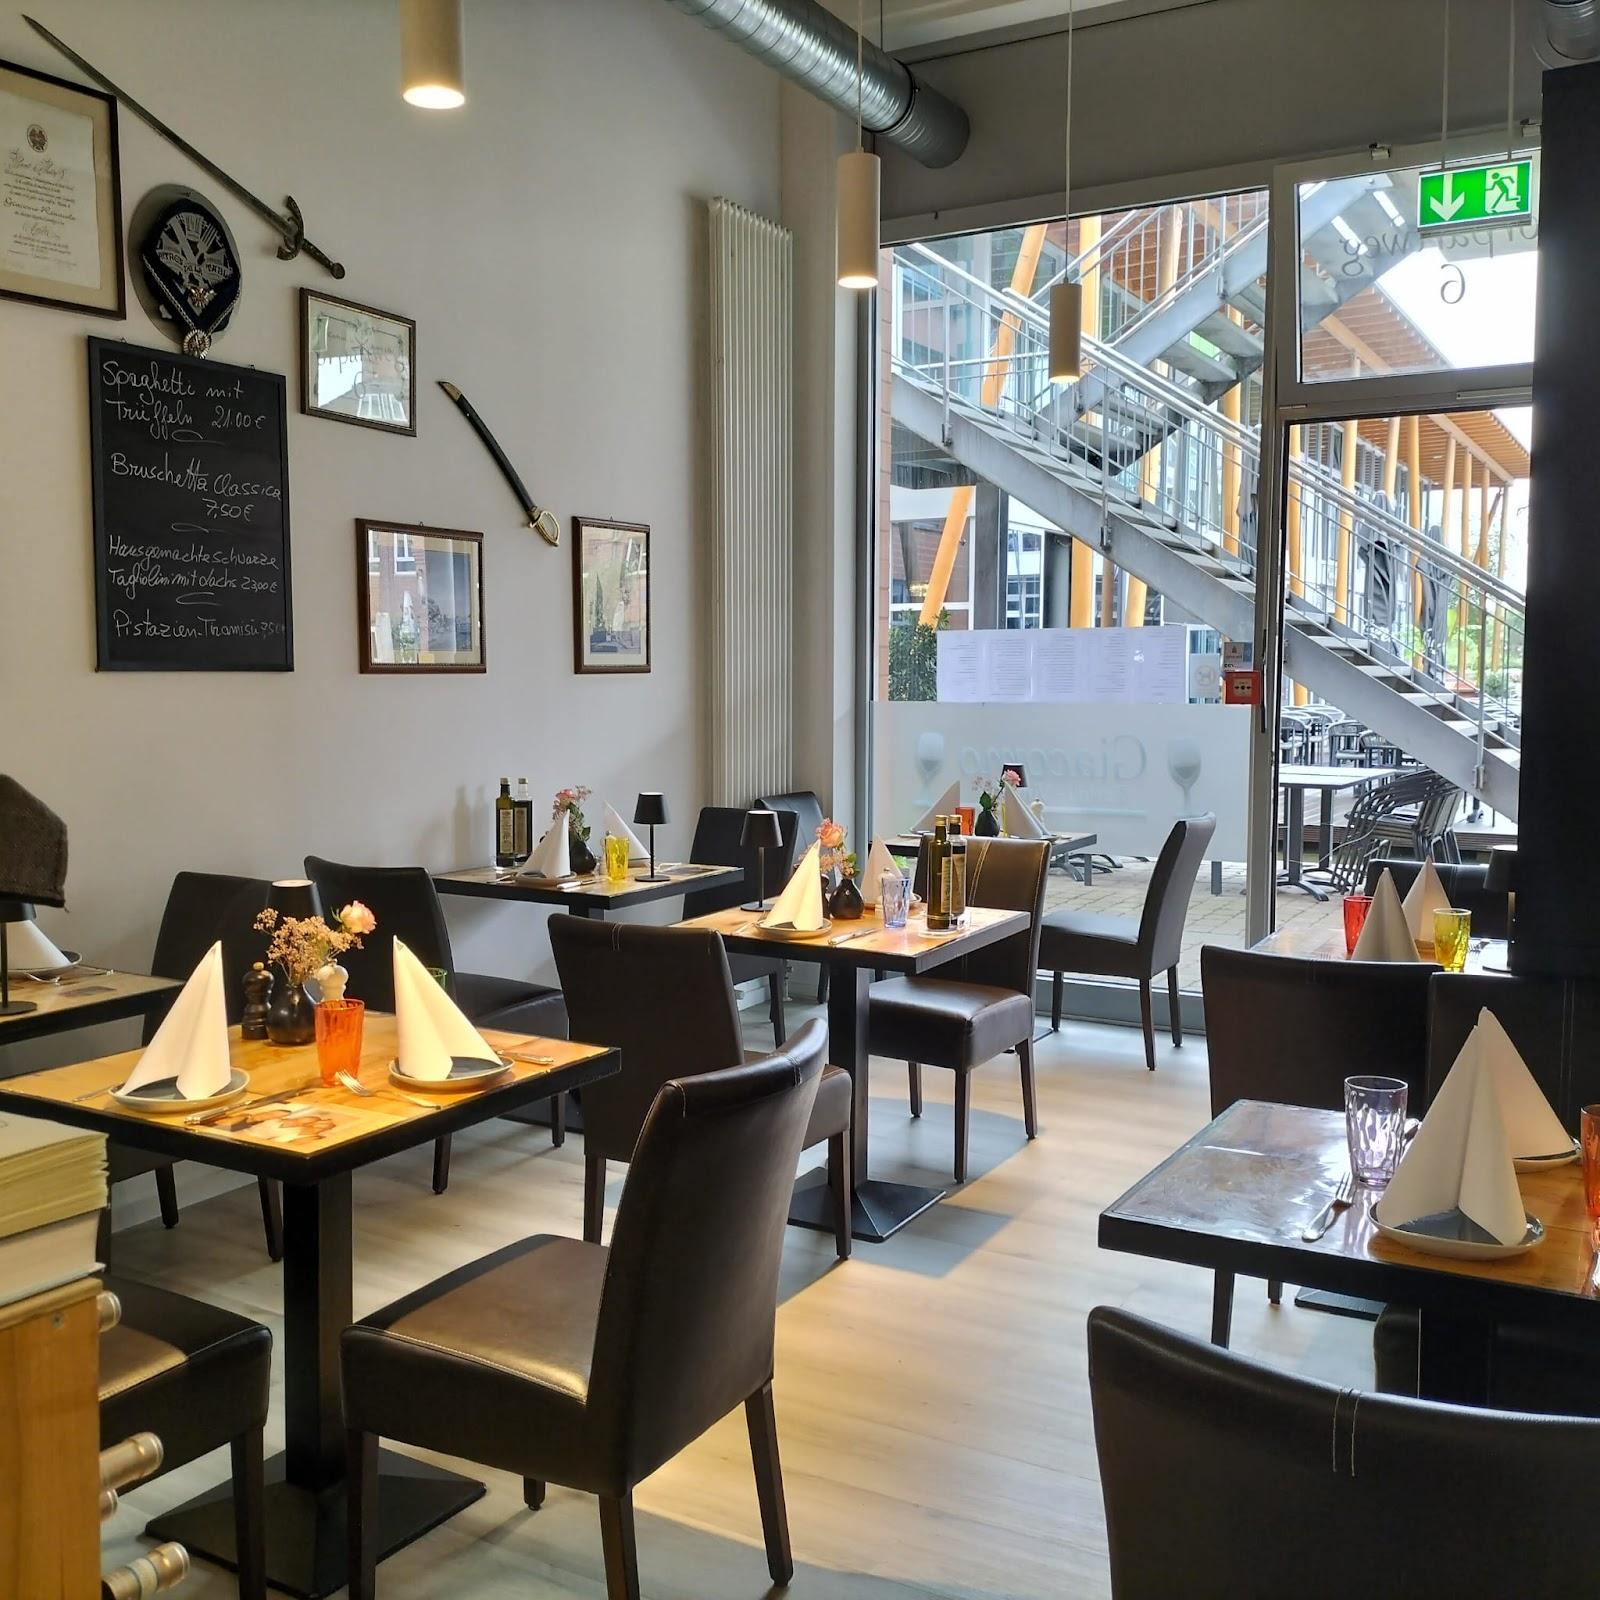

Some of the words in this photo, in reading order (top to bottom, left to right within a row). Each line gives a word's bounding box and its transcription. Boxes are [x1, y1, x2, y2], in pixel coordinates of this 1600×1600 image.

[102, 360, 196, 405] Spaghetti
[206, 379, 244, 399] mit
[104, 398, 193, 440] Trüffeln
[110, 451, 209, 492] Bruschetta
